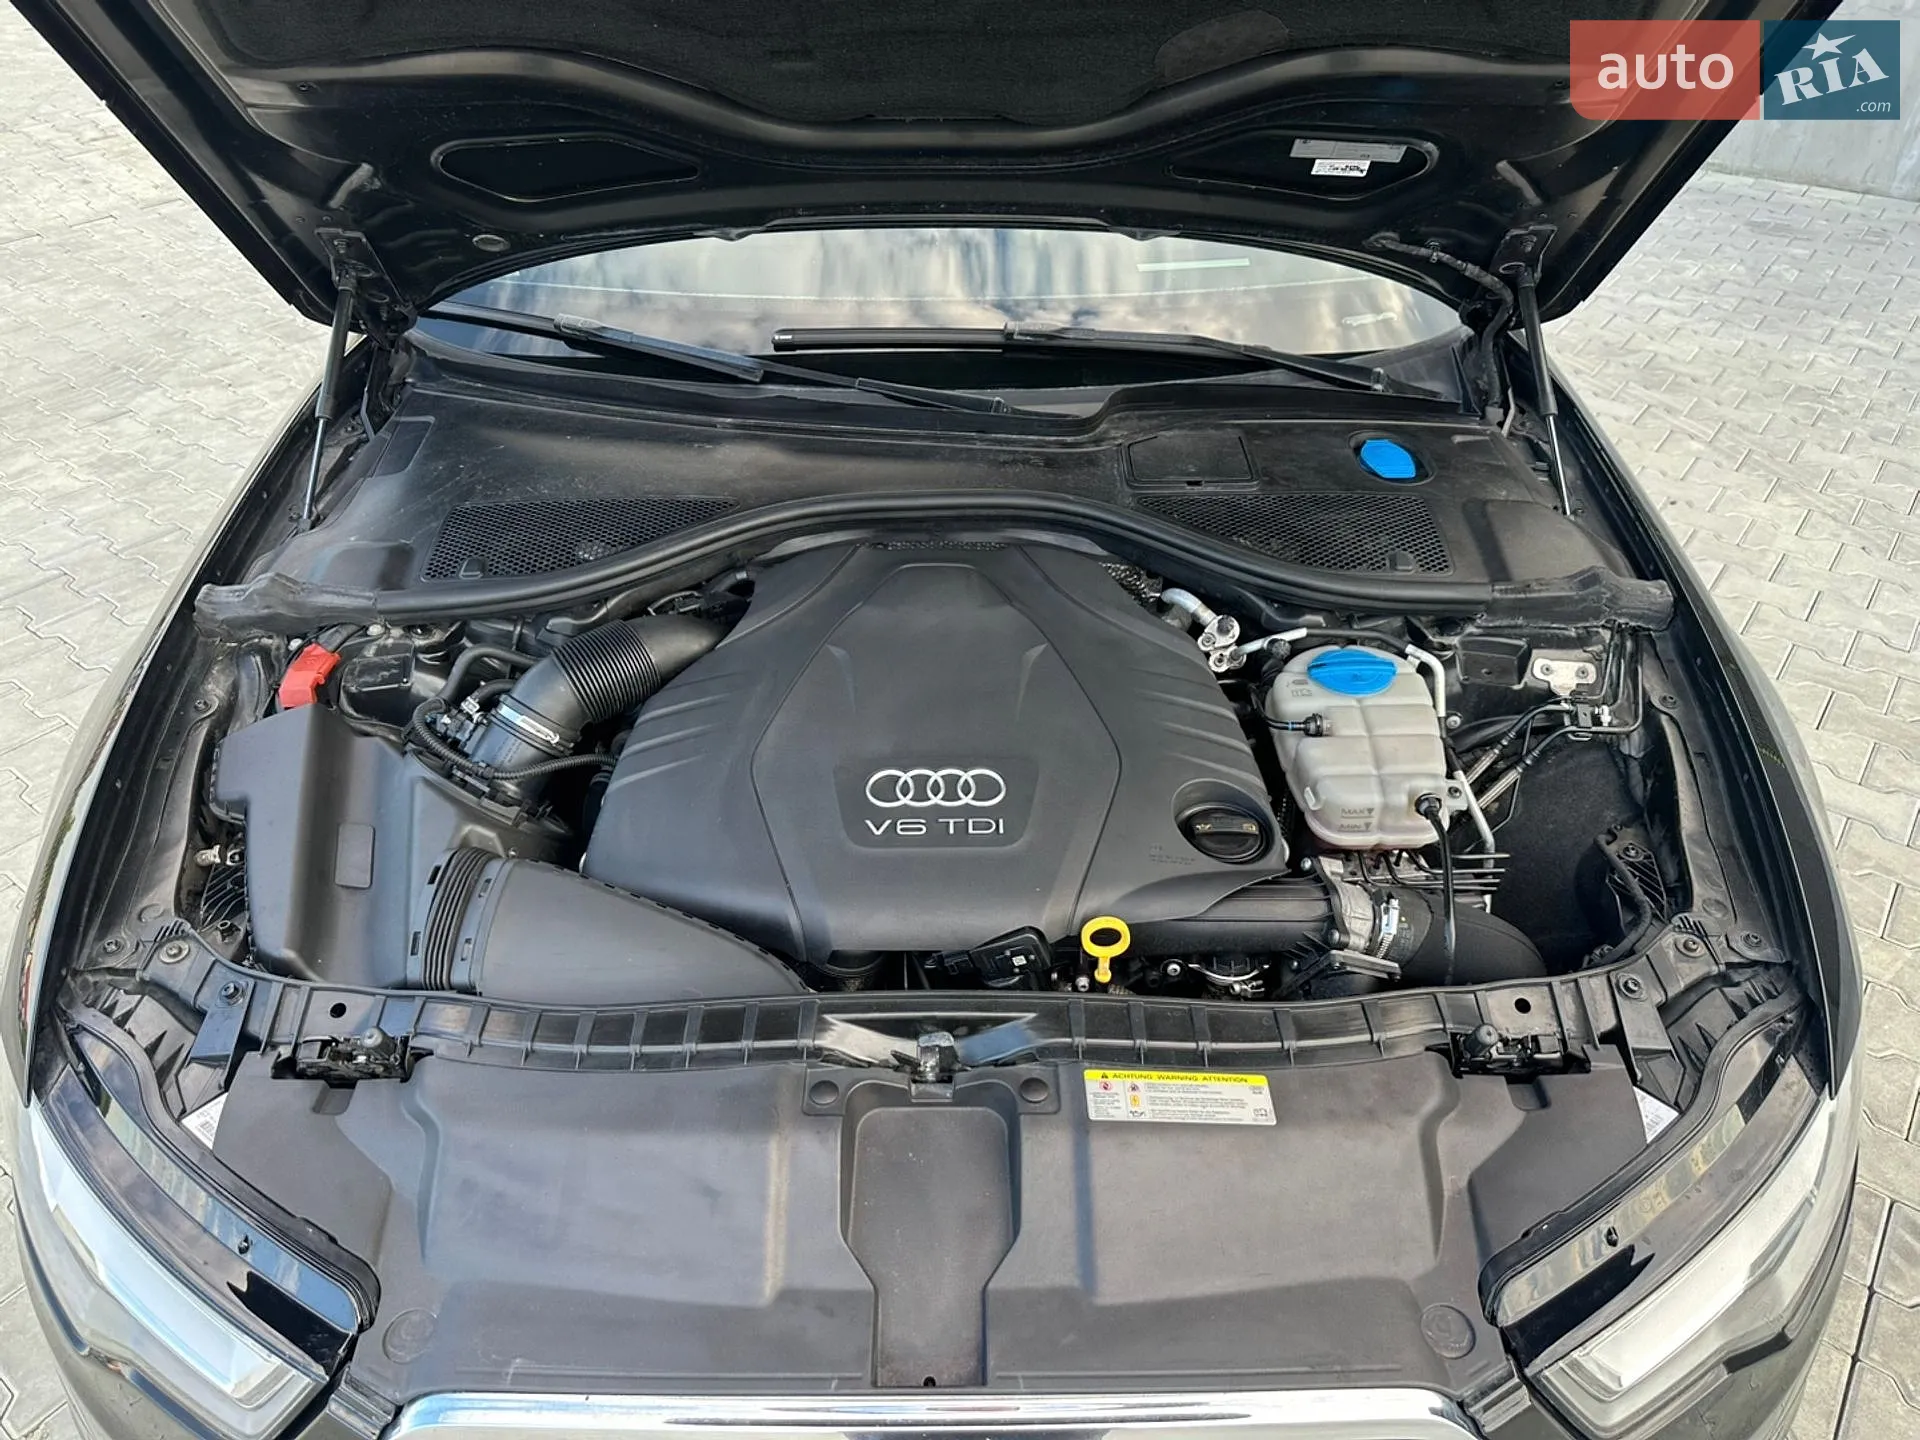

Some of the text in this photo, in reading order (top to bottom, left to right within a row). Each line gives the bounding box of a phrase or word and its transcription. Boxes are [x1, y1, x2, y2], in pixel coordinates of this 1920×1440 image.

[864, 818, 1005, 836] V6 TDI
[1112, 1072, 1249, 1083] ACHTUNG WARNING ATTENTION
